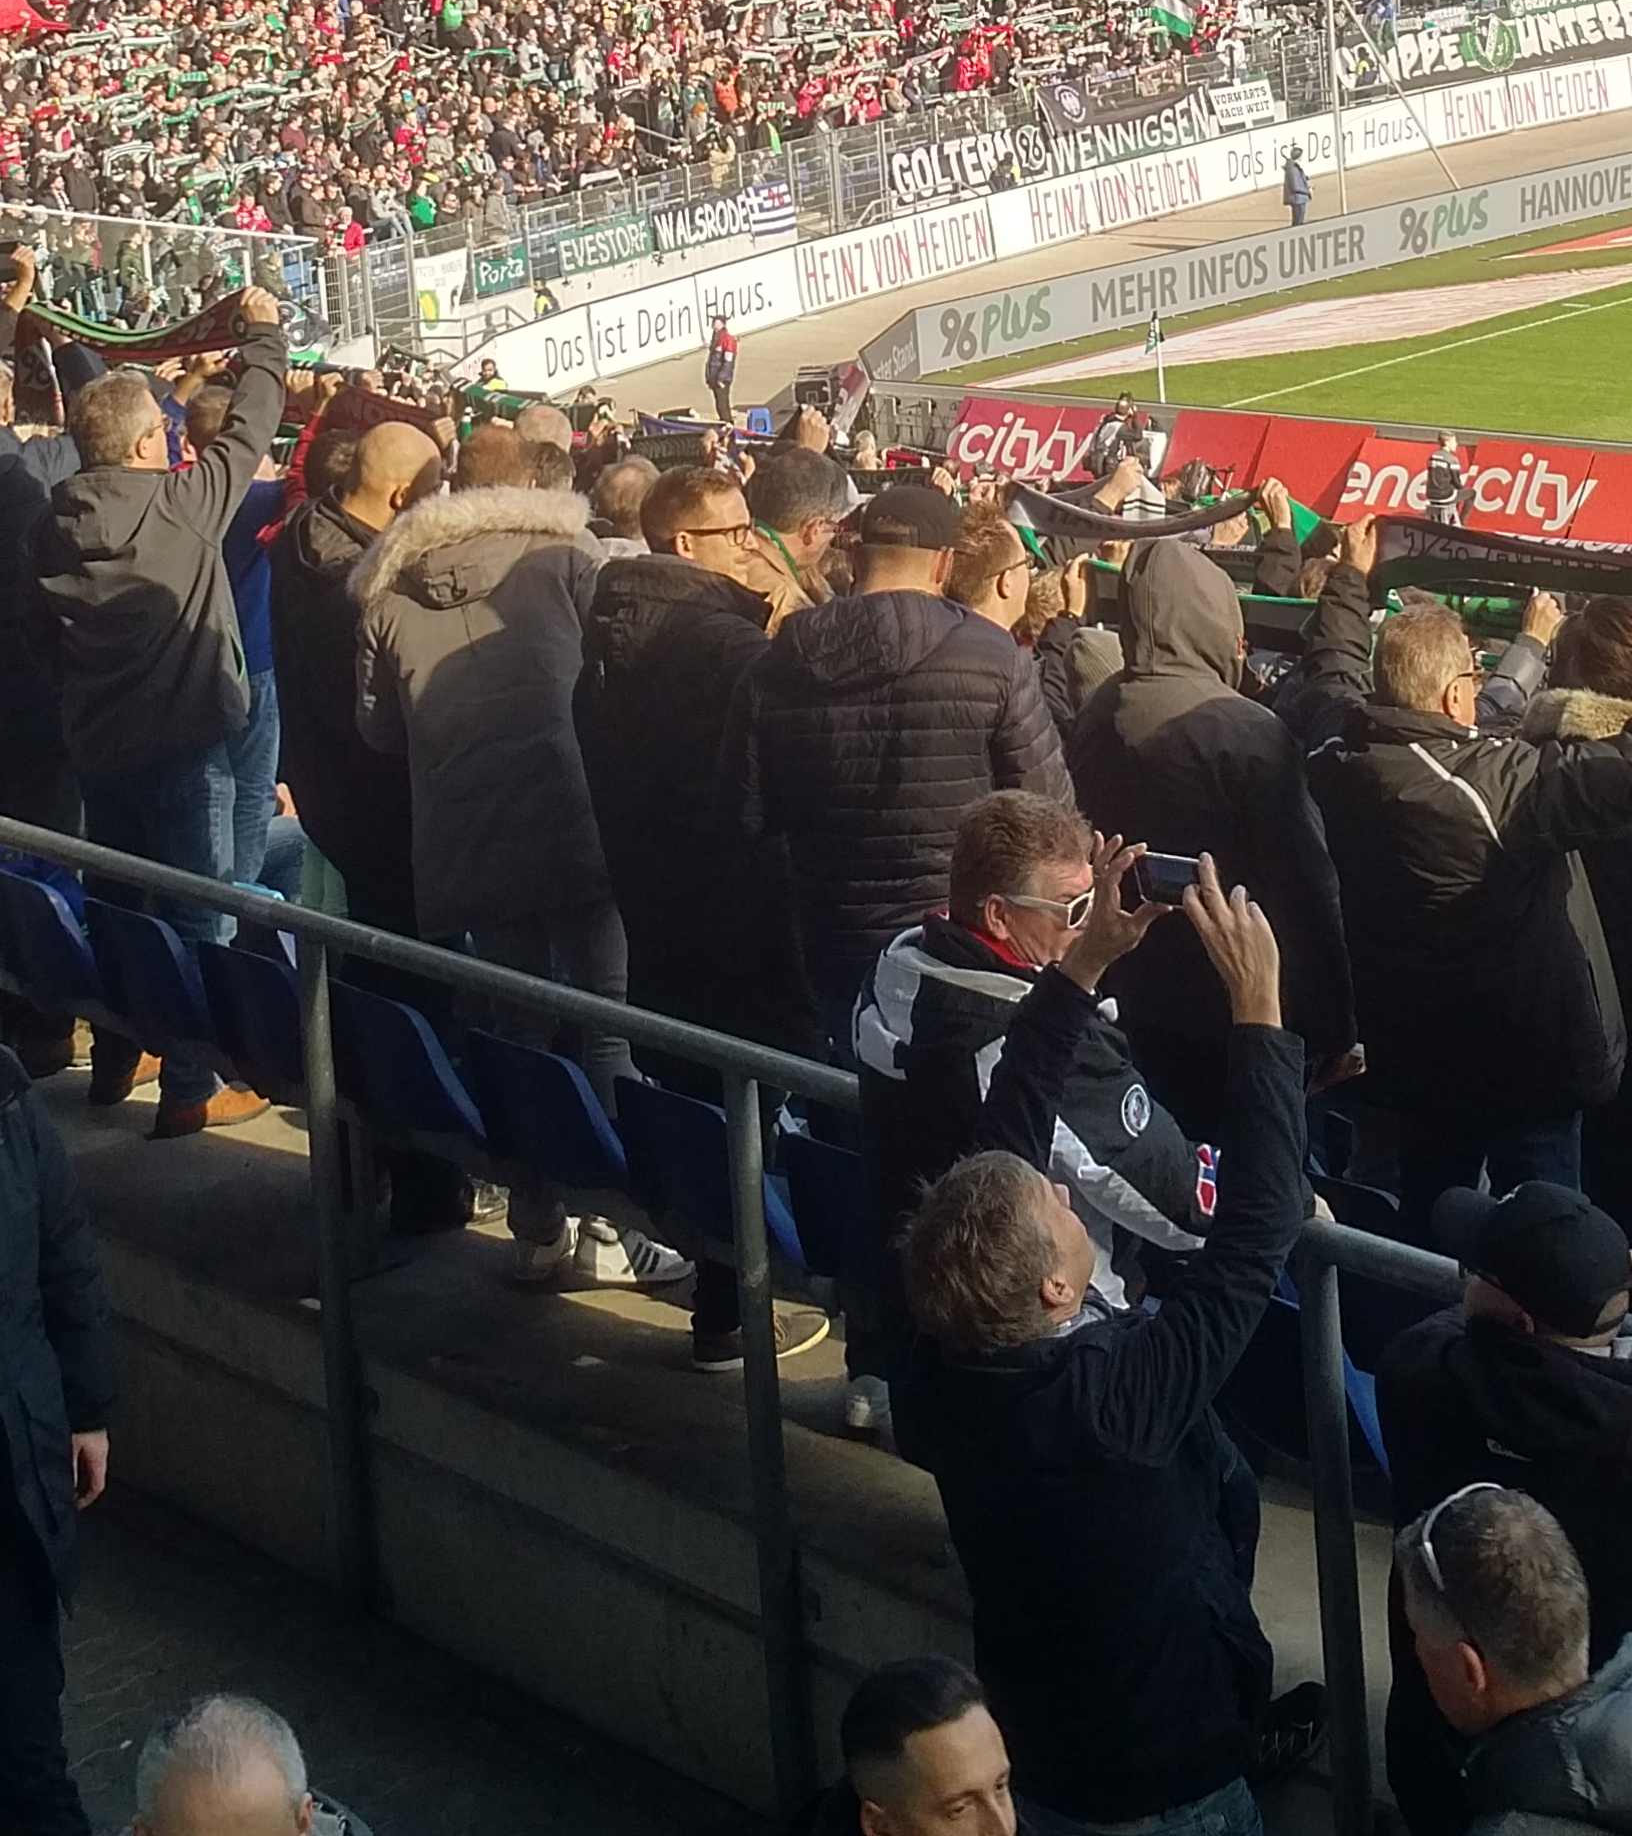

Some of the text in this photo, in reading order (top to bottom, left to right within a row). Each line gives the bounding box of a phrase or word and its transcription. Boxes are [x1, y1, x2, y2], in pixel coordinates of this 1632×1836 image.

[1048, 89, 1218, 175] WENNIGSEN
[1246, 100, 1271, 114] WEIT
[1442, 66, 1610, 142] HEINZ VON HEIDEN
[1227, 148, 1264, 183] Das
[1363, 114, 1420, 152] Haus.
[653, 193, 750, 252] WALSRODE
[1027, 156, 1203, 245] HEINZ VON HEIDEN
[479, 258, 525, 288] Porta
[559, 222, 648, 271] EVESTORF
[802, 208, 990, 308] HEINZ VON HEIDEN
[1091, 265, 1178, 324] MEHR
[1188, 244, 1268, 300] INFOS
[1278, 224, 1366, 280] UNTER
[544, 280, 773, 378] Das ist Dein Haus.
